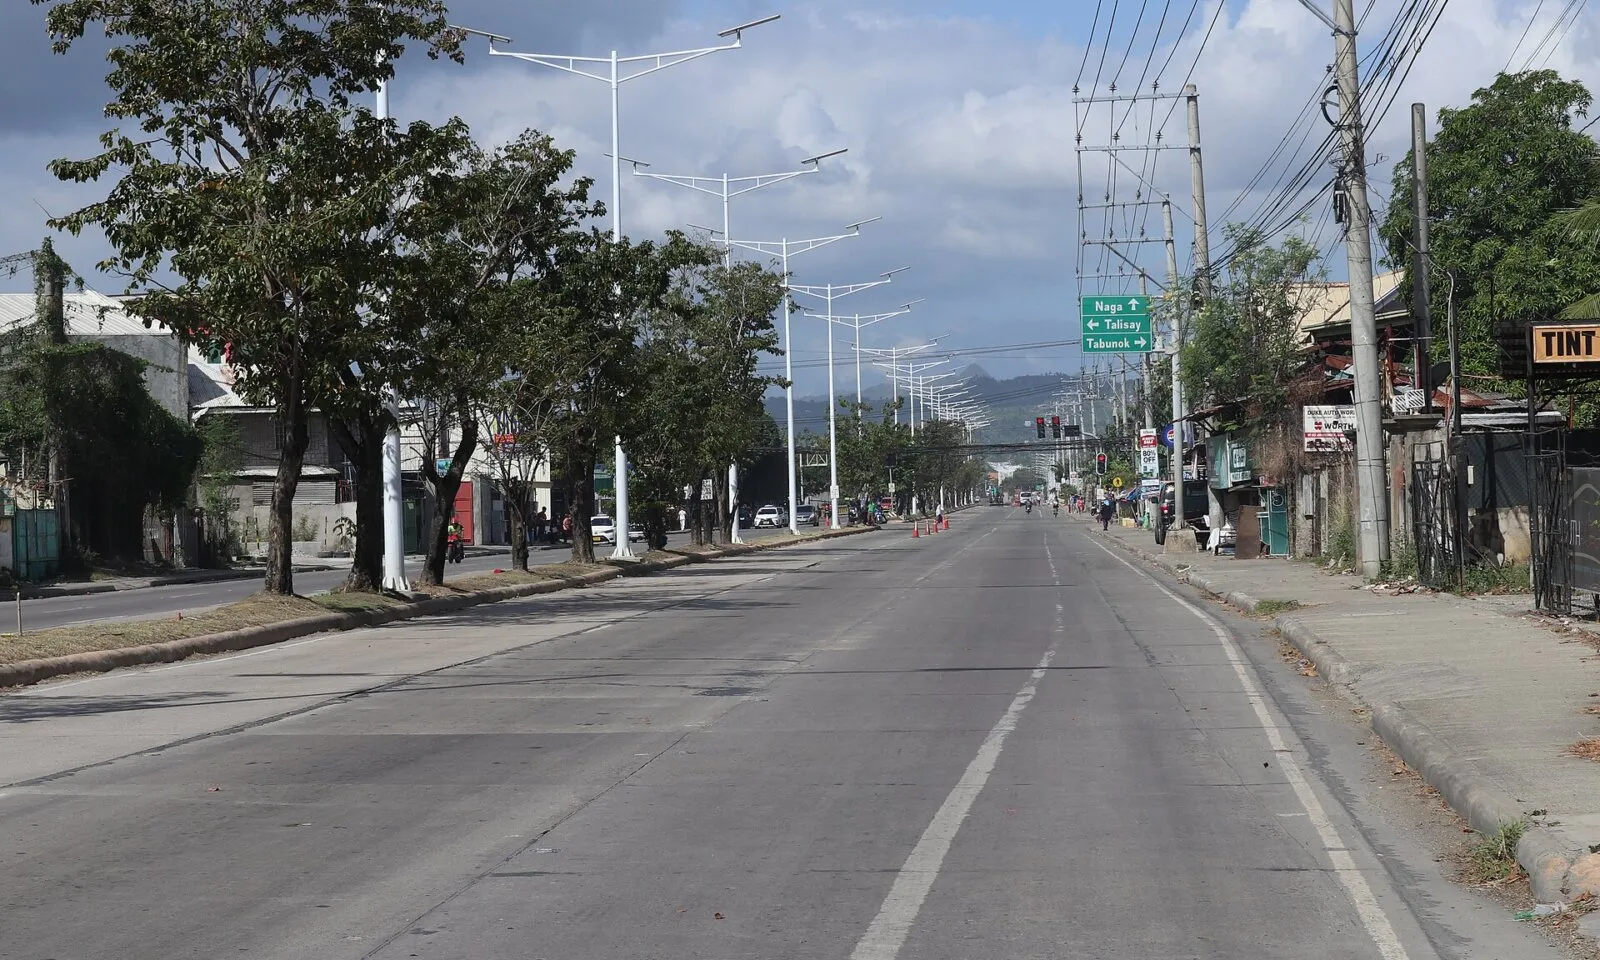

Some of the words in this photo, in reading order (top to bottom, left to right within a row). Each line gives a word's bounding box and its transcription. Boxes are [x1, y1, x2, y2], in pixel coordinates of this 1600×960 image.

[1095, 301, 1122, 314] Naga
[1104, 319, 1141, 332] Talisay
[1086, 338, 1130, 349] Tabunok
[1541, 331, 1596, 356] TINT
